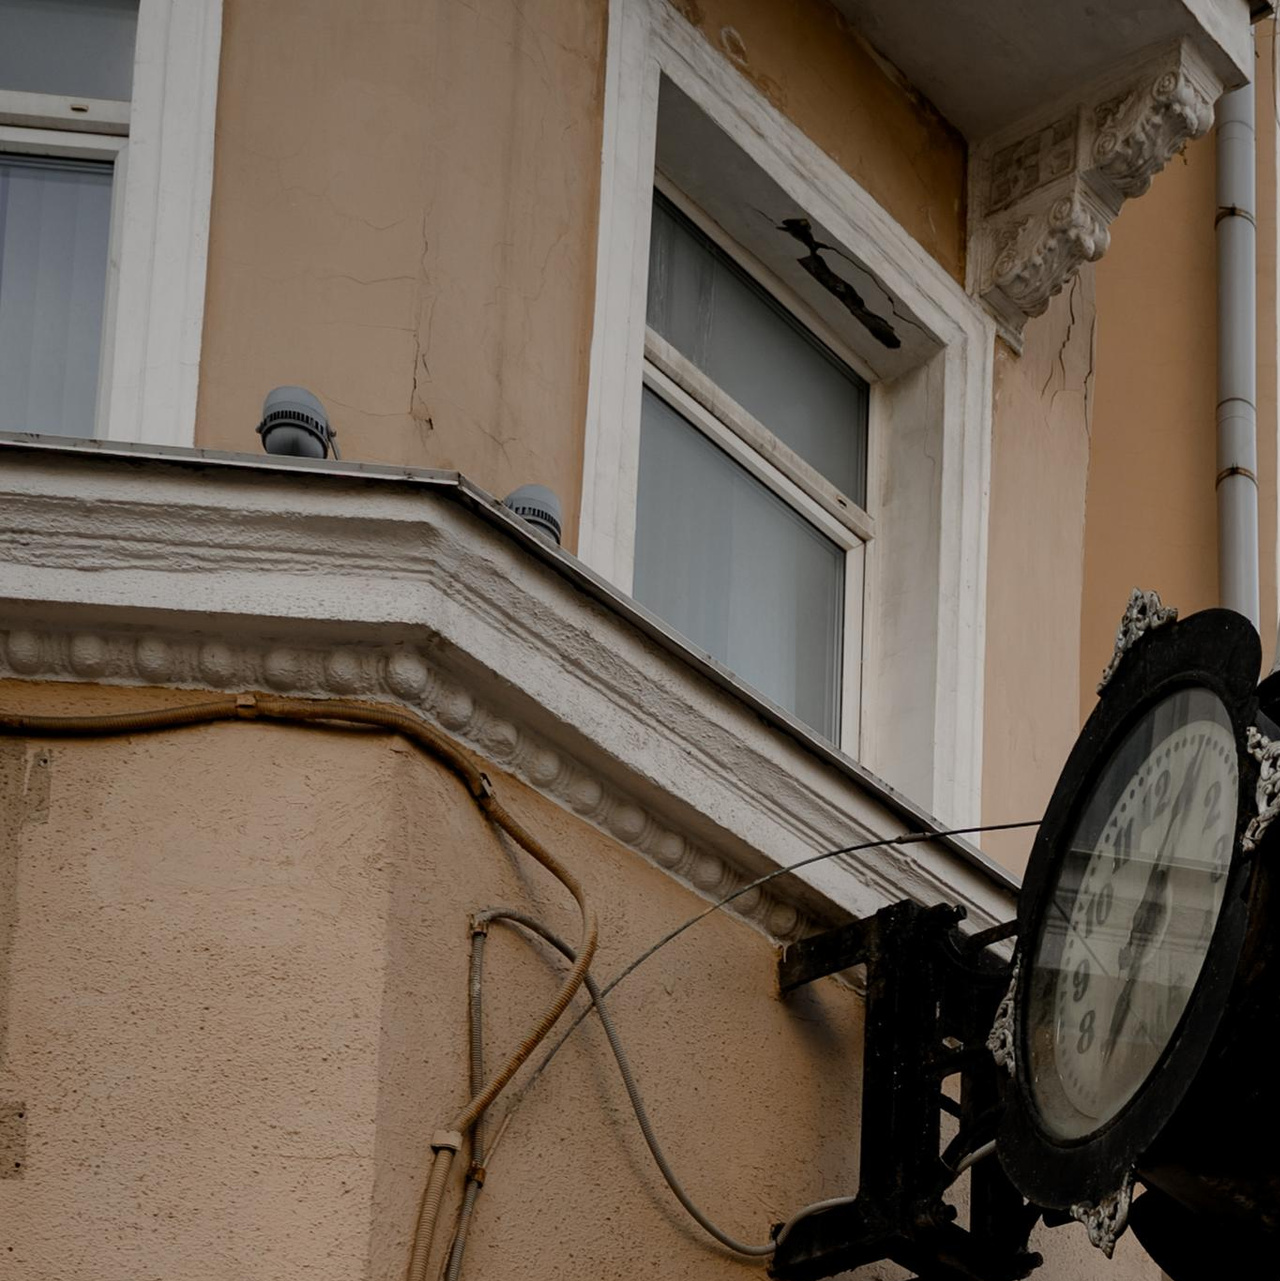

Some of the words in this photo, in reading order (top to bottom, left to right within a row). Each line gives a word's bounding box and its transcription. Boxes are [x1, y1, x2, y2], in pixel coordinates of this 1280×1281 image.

[1203, 780, 1223, 835] 2
[1112, 817, 1135, 876] 11
[1212, 832, 1230, 884] 3
[1084, 883, 1114, 939] 10
[1073, 959, 1090, 1003] 9
[1077, 1010, 1096, 1055] 8
